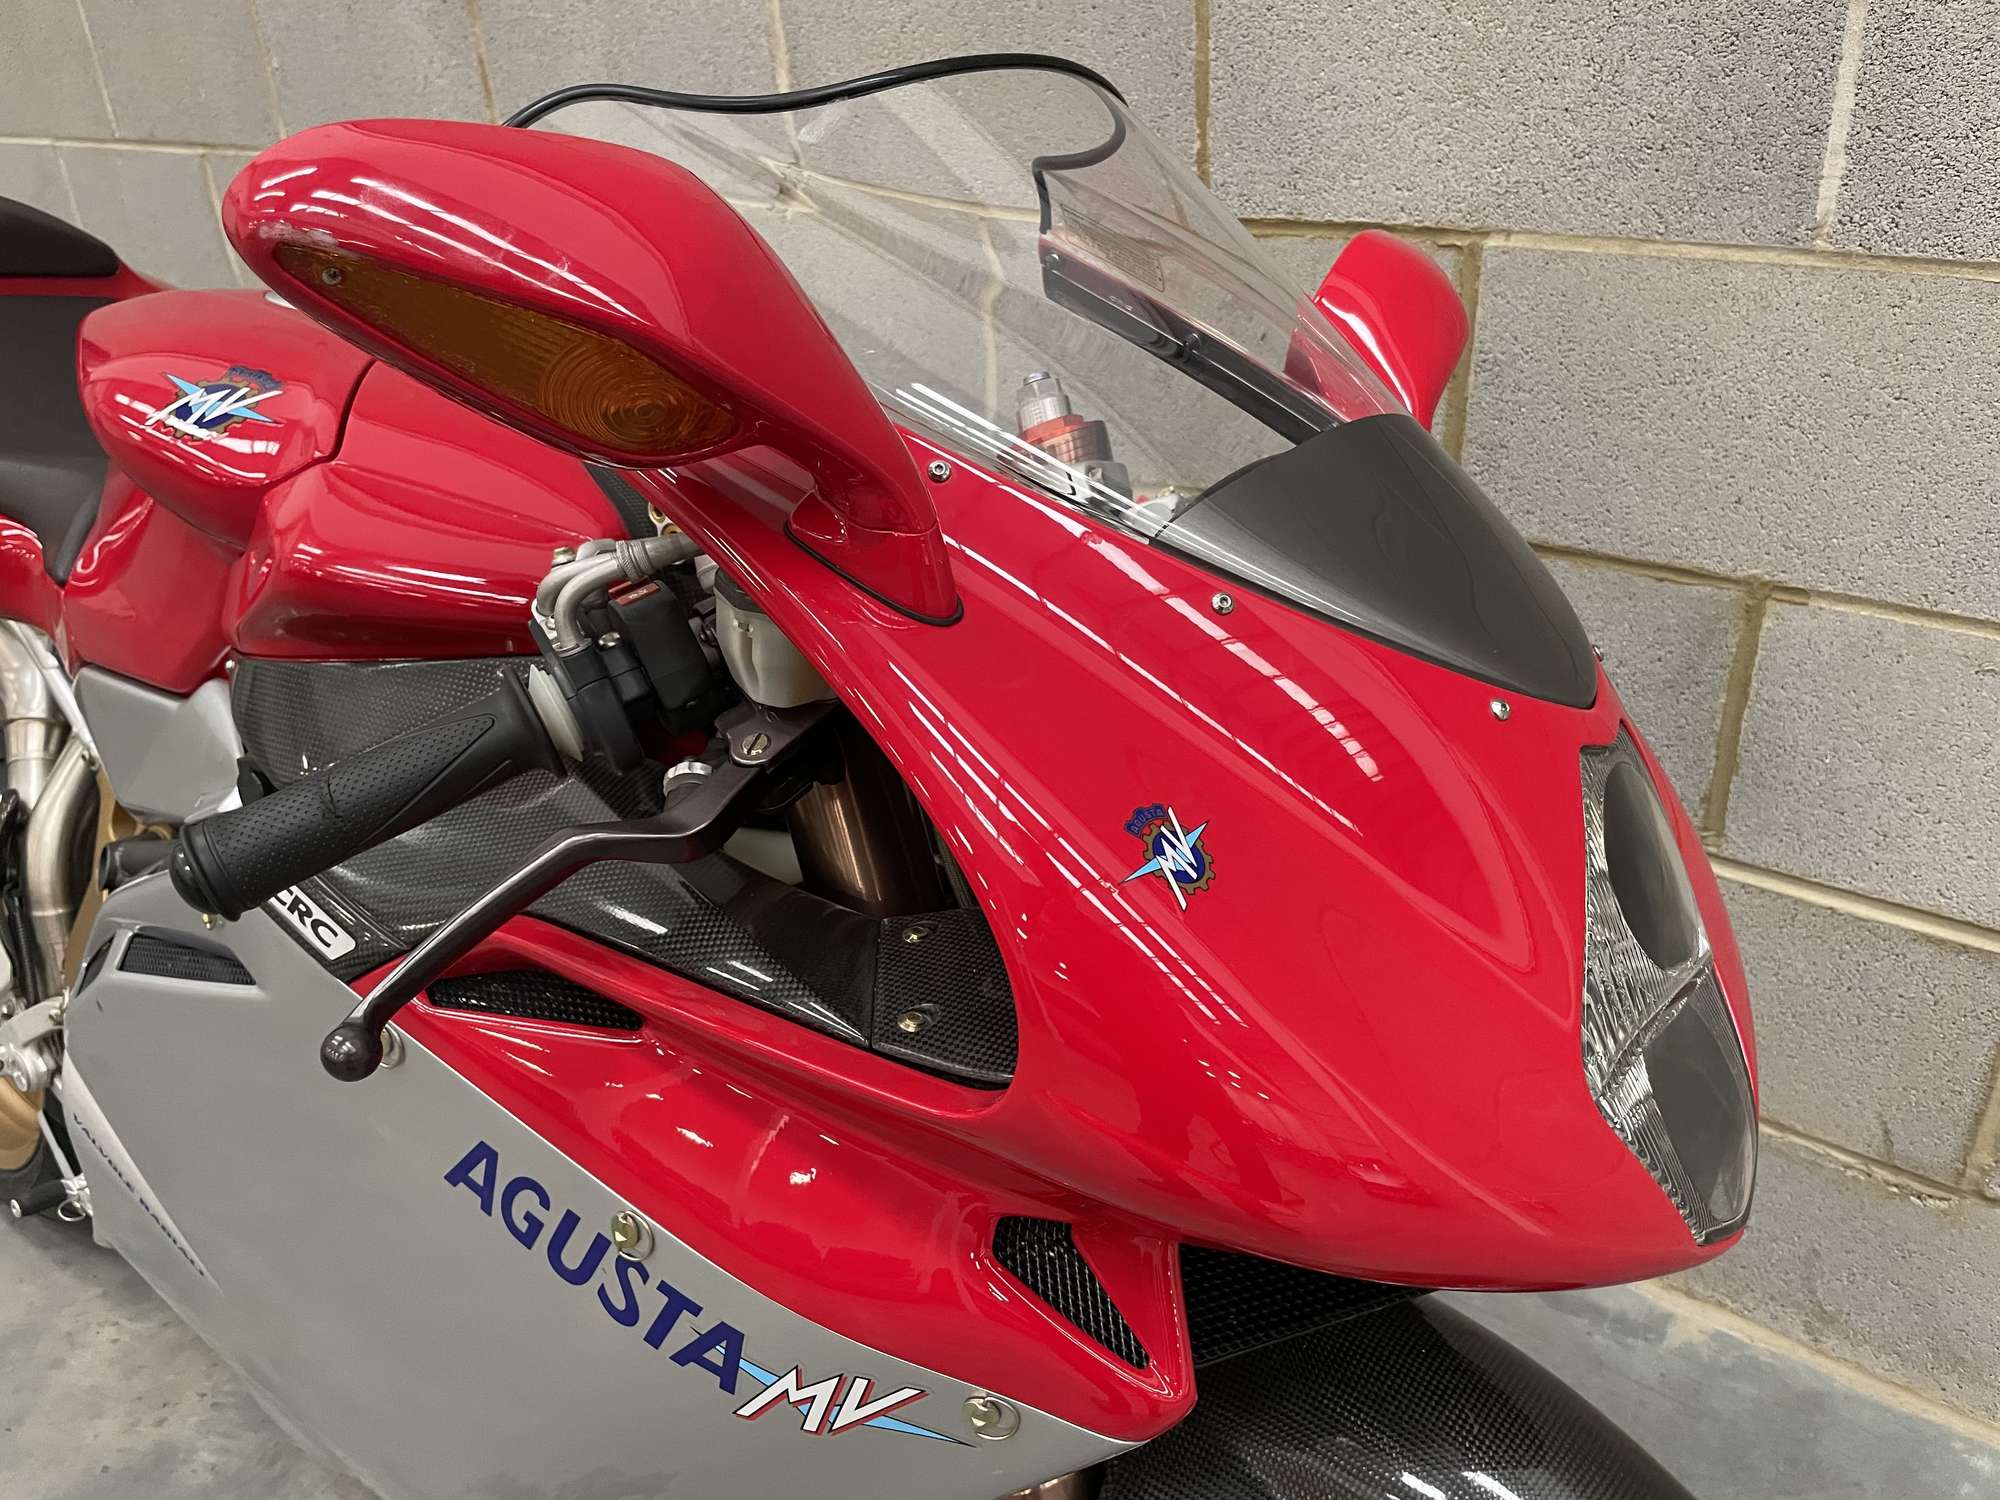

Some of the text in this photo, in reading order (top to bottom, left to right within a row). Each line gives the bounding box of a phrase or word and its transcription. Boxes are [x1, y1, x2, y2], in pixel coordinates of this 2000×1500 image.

[144, 386, 283, 427] MV
[1128, 806, 1166, 834] AGUSTA
[1155, 804, 1198, 912] MV
[443, 1140, 930, 1437] AGUSTA MV
